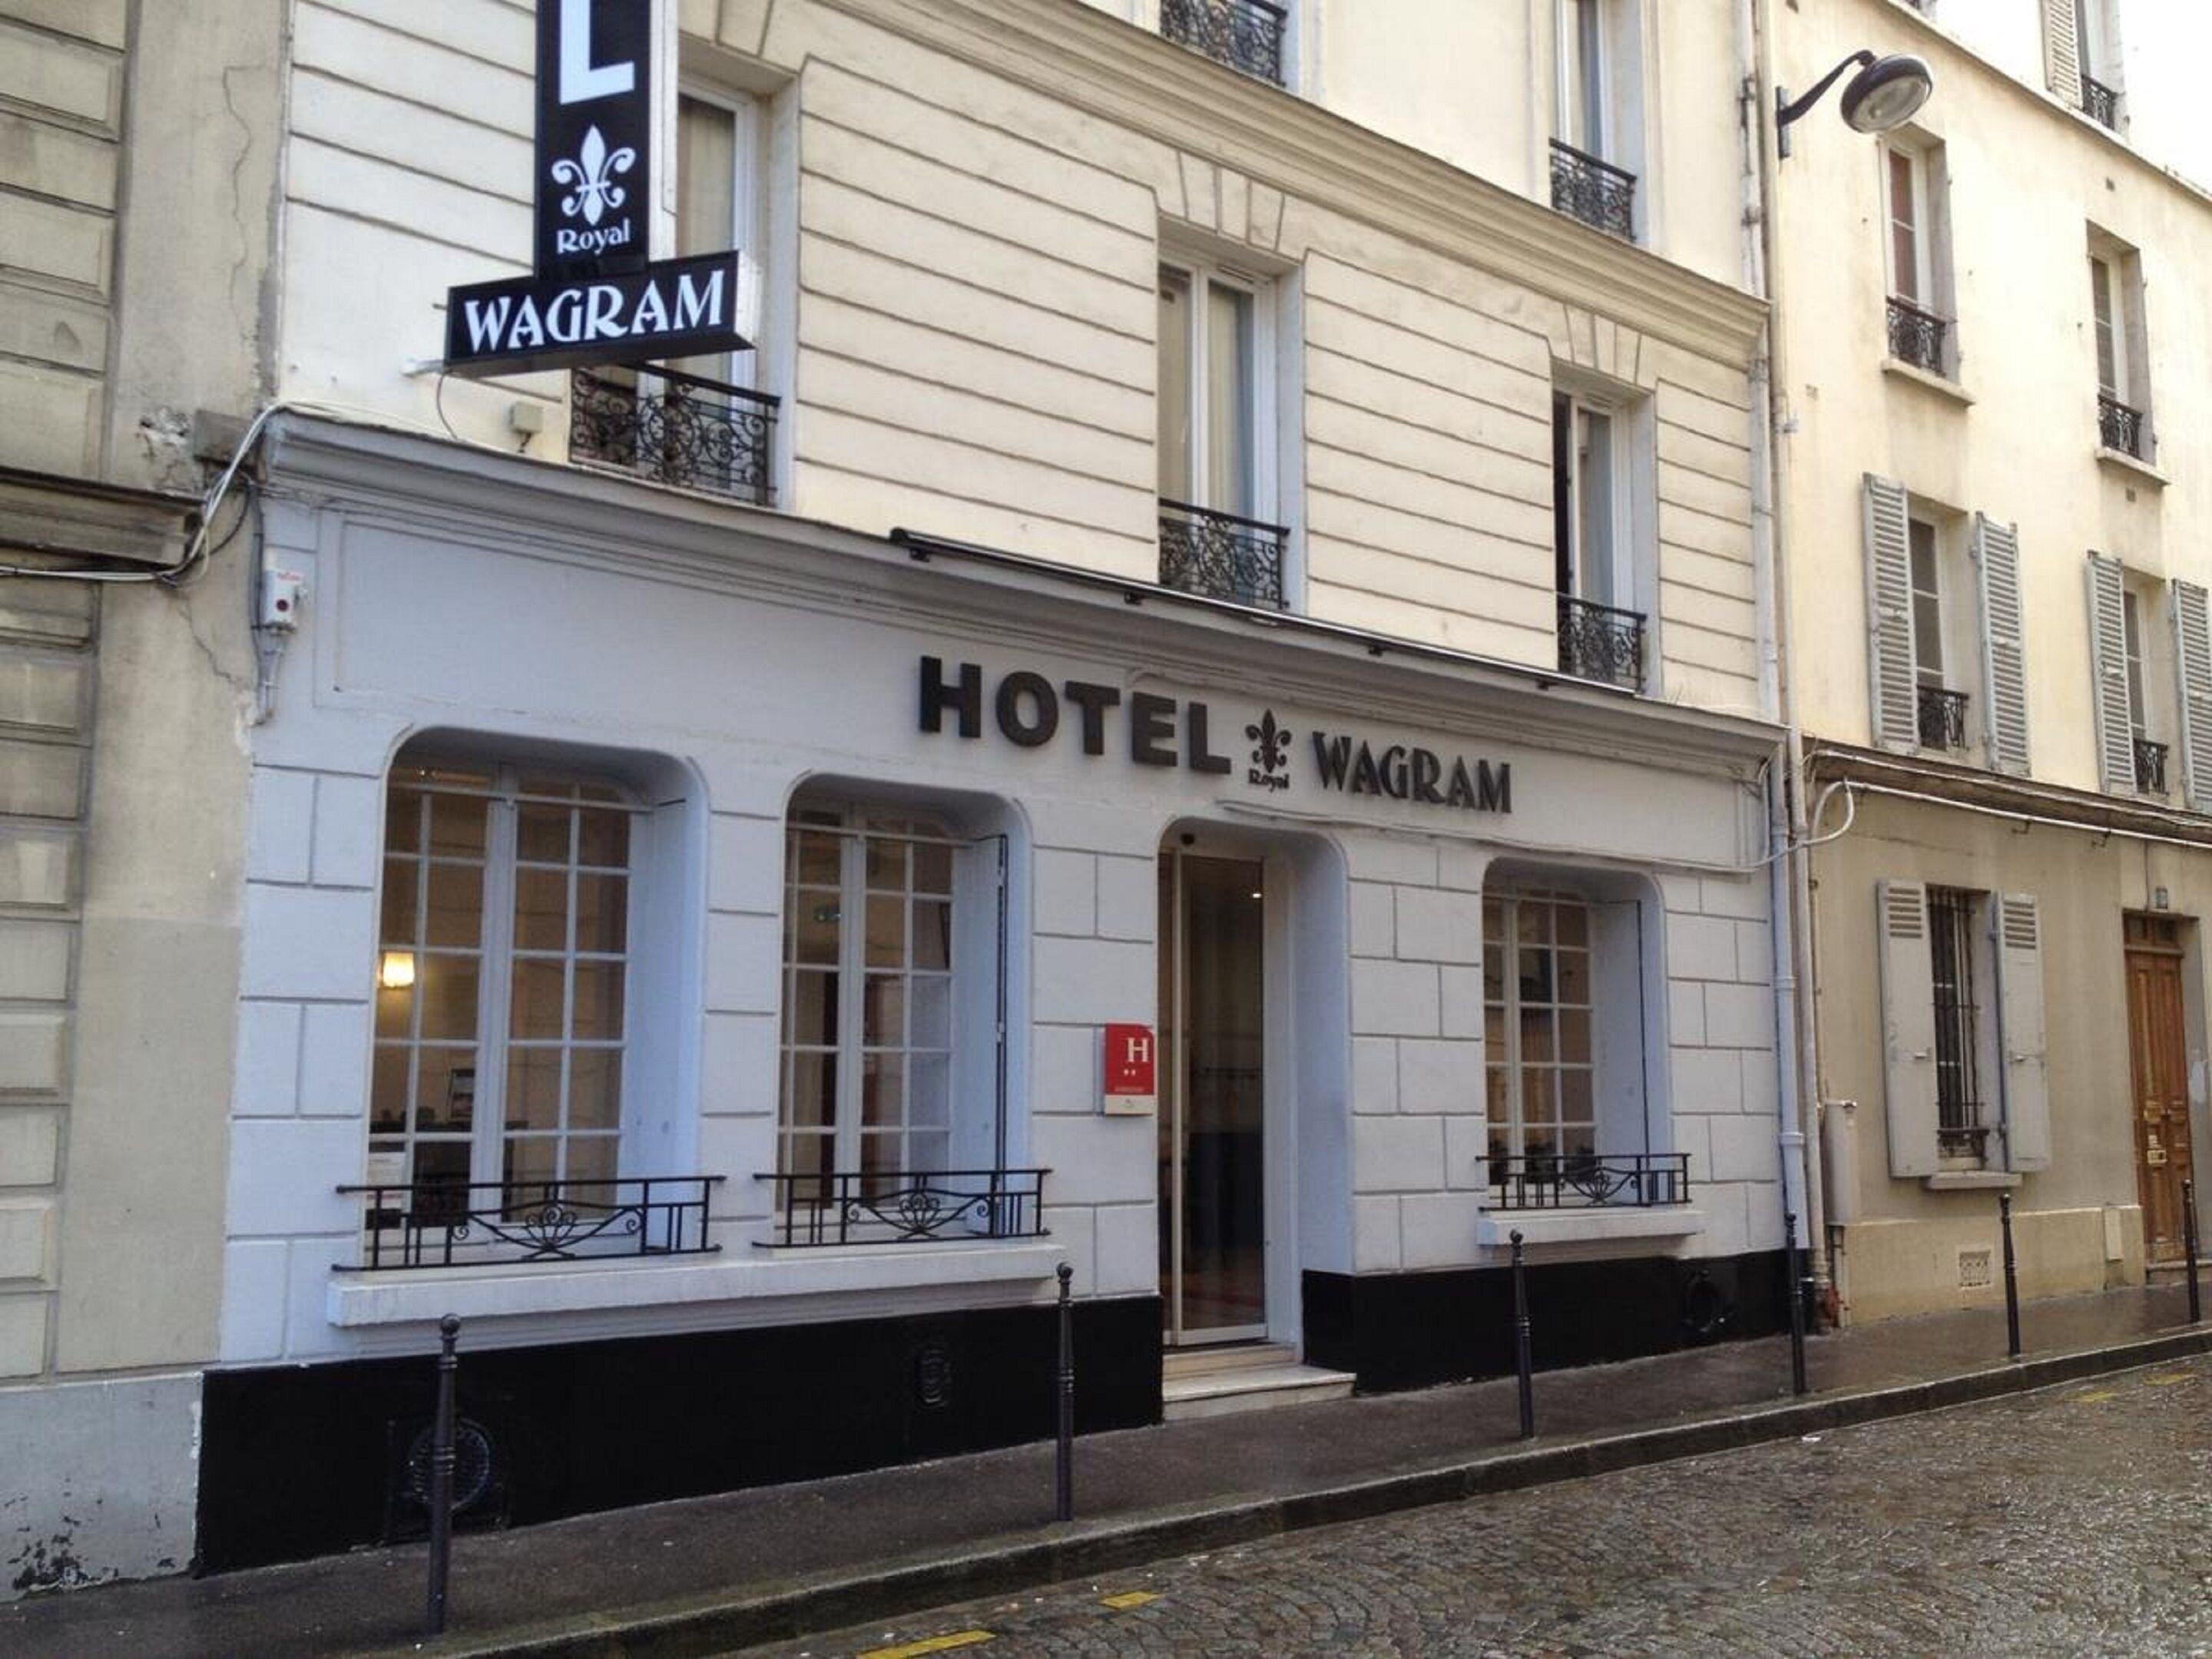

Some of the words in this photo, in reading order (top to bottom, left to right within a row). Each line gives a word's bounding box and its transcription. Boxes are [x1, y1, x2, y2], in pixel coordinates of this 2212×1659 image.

[560, 0, 634, 104] L
[557, 218, 631, 255] Royal
[465, 270, 724, 353] WAGRAM
[919, 656, 1231, 775] HOTEL
[1248, 769, 1290, 793] Royal
[1312, 731, 1512, 814] WAGRAM
[1128, 1038, 1148, 1062] H
